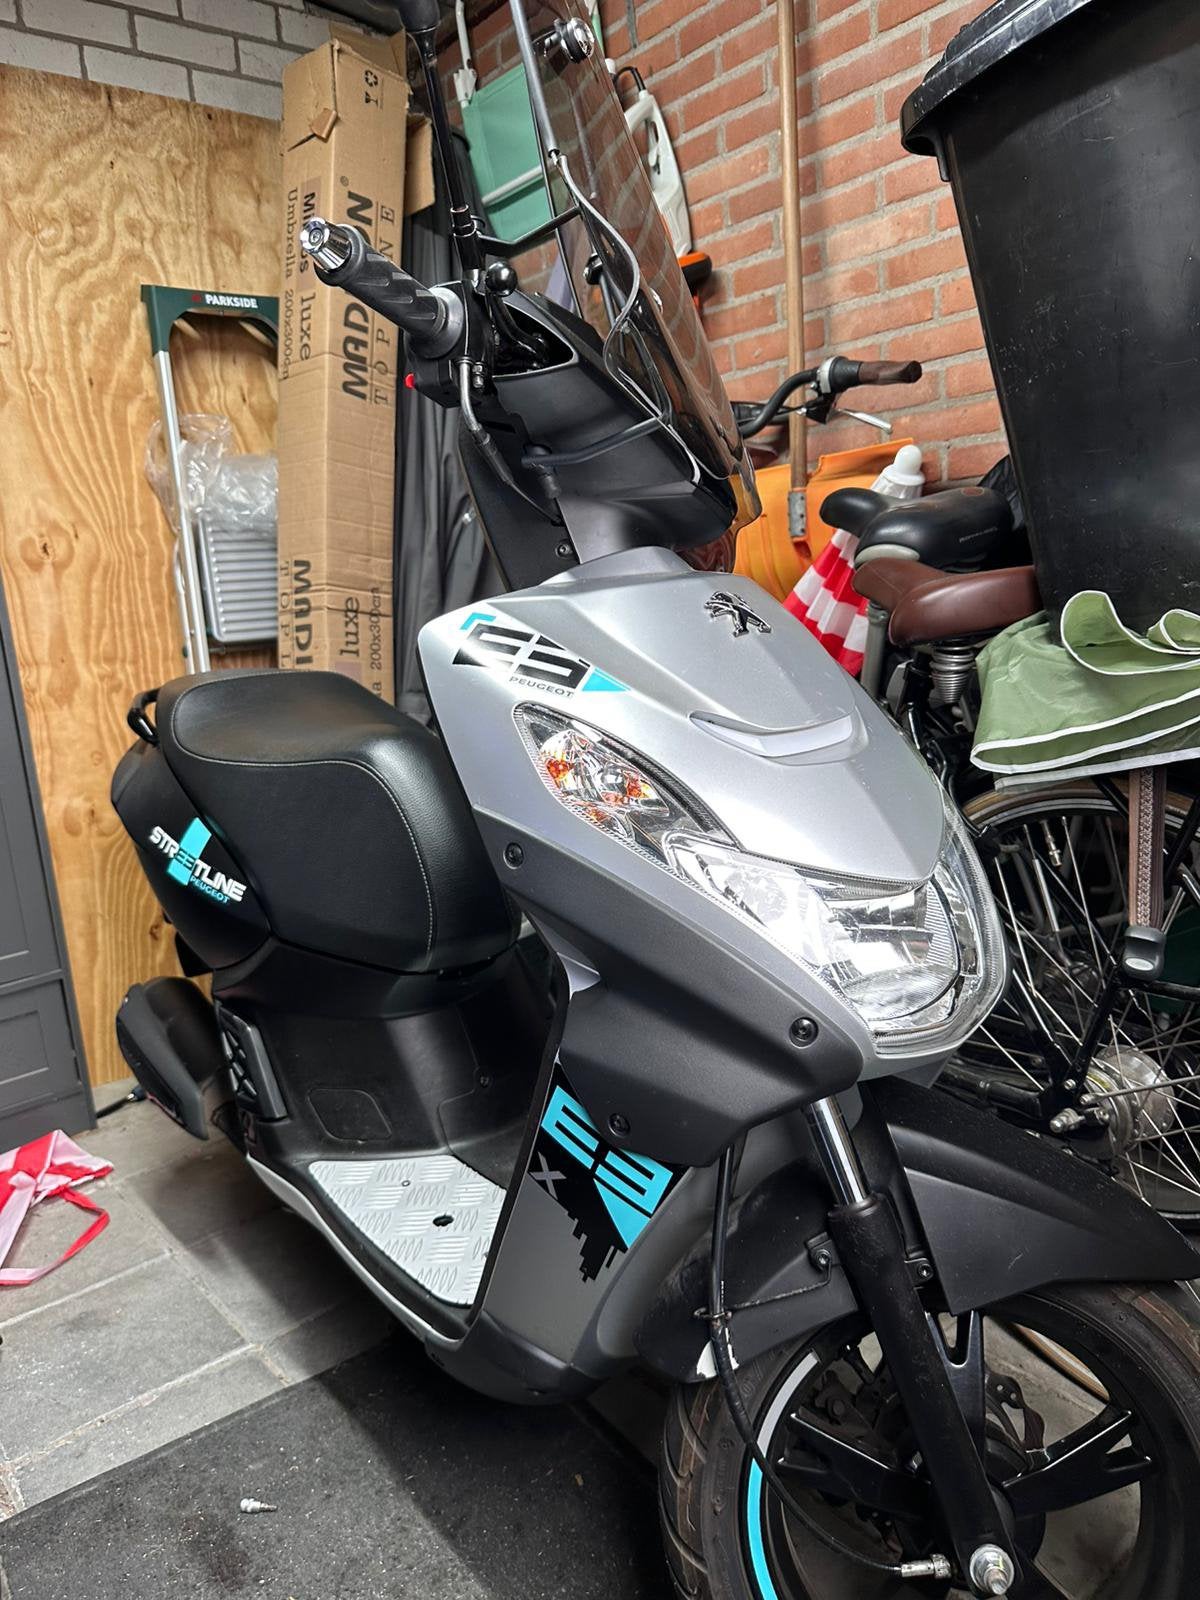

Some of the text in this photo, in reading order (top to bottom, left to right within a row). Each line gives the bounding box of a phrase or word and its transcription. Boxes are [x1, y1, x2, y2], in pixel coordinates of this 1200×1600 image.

[285, 187, 298, 279] Umbrella
[205, 294, 258, 308] PARKSIDE
[299, 291, 317, 361] luxe
[339, 596, 360, 658] luxe
[368, 587, 382, 671] 200x300cm
[508, 675, 576, 698] PEUGEOT
[189, 874, 231, 904] PEUGEOT
